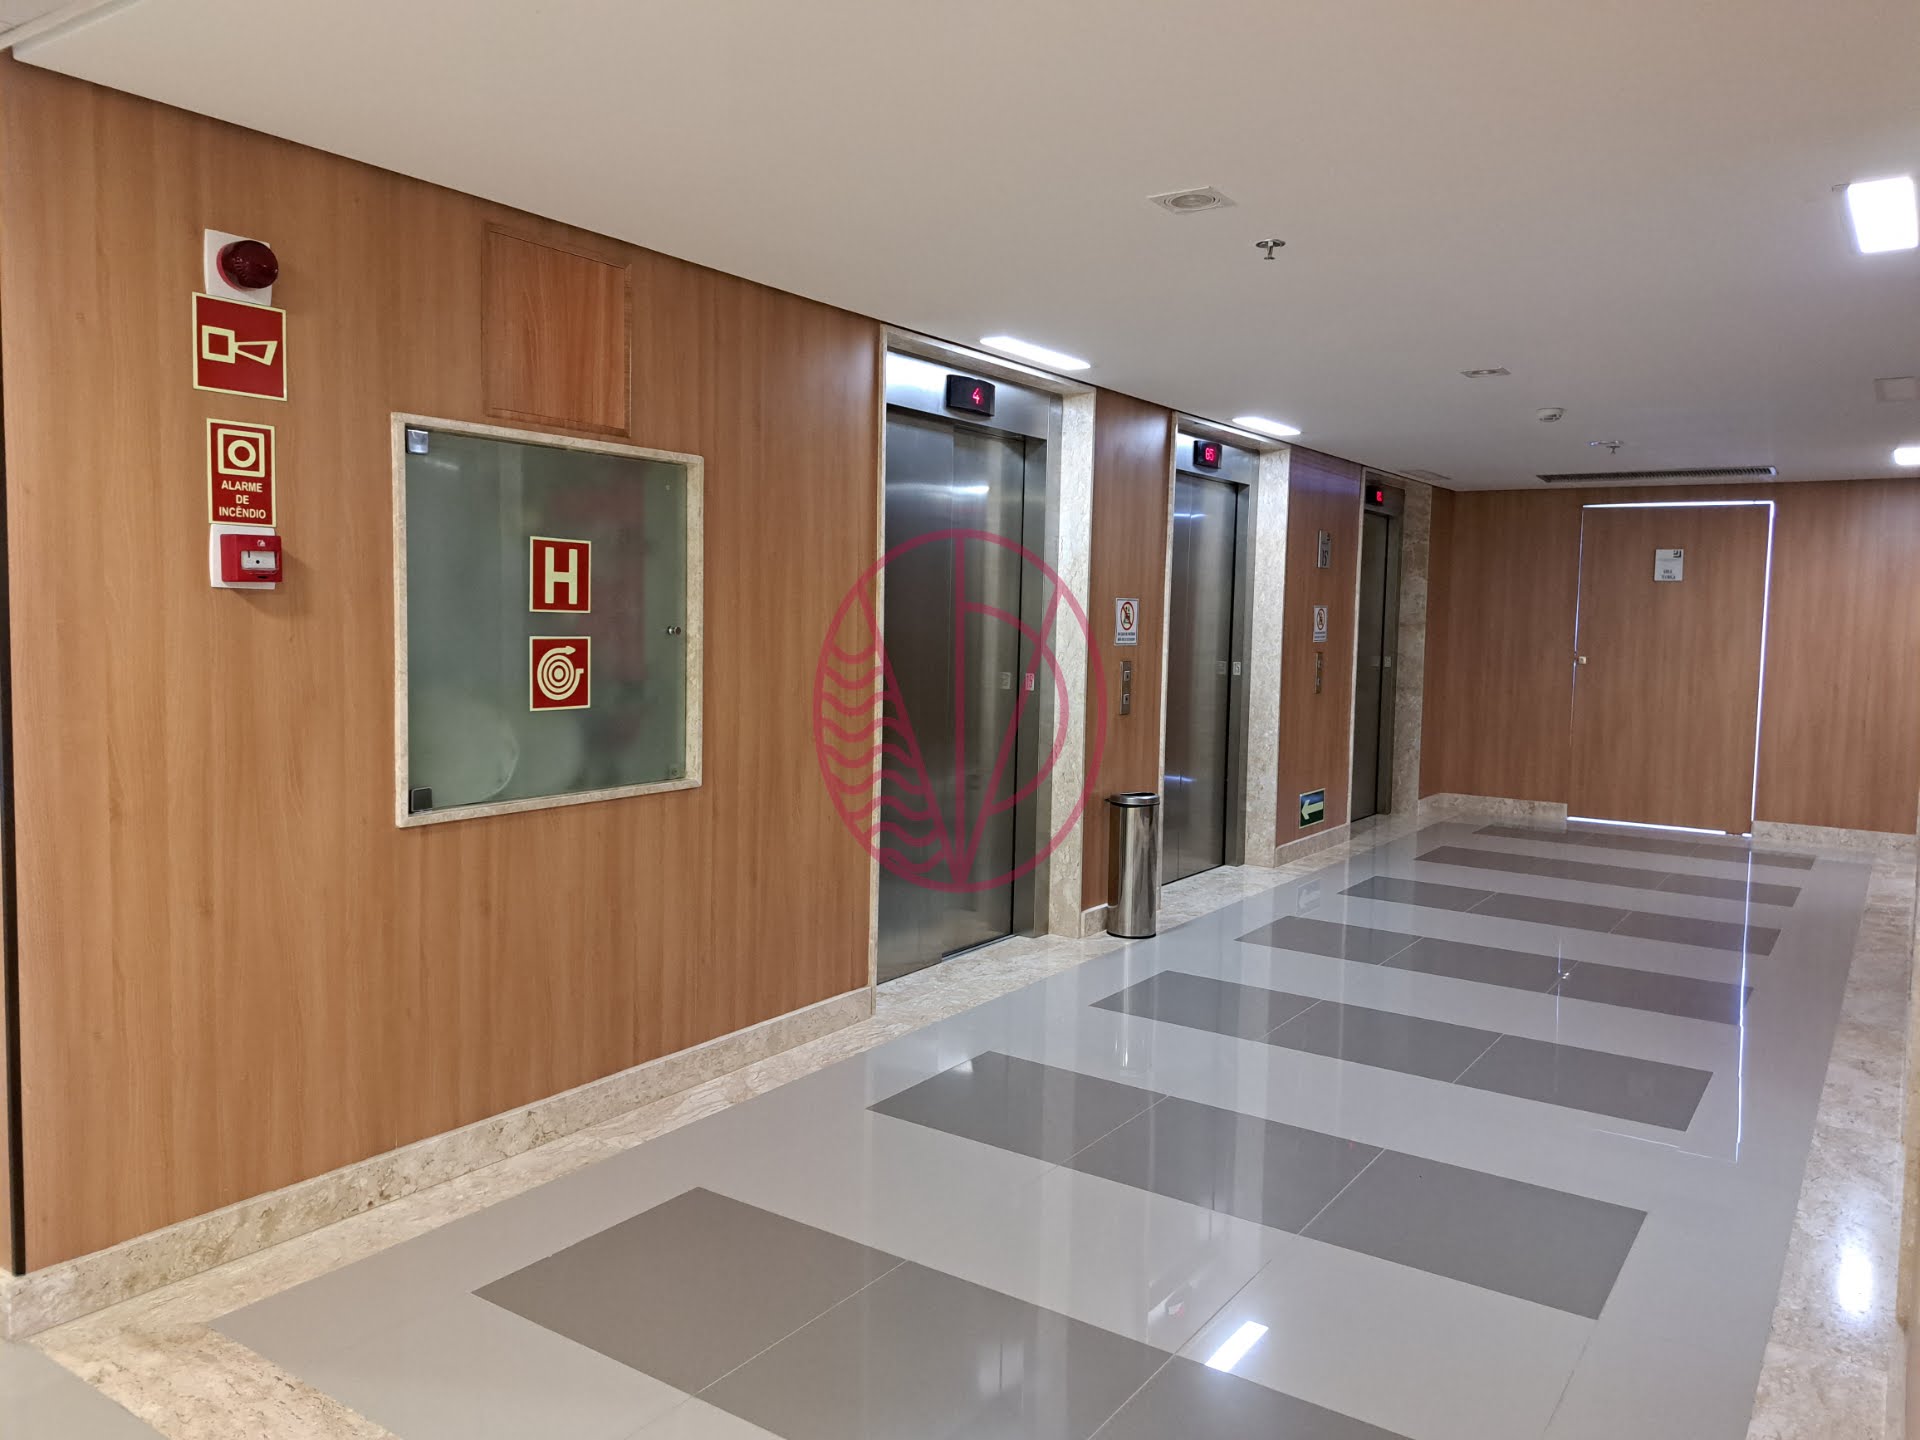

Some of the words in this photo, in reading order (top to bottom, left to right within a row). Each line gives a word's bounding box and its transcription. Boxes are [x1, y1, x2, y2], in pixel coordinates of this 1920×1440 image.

[972, 387, 981, 405] 4
[221, 480, 263, 493] ALARME
[235, 494, 250, 505] DE
[218, 506, 266, 519] INCÊNDIO
[544, 546, 578, 605] H
